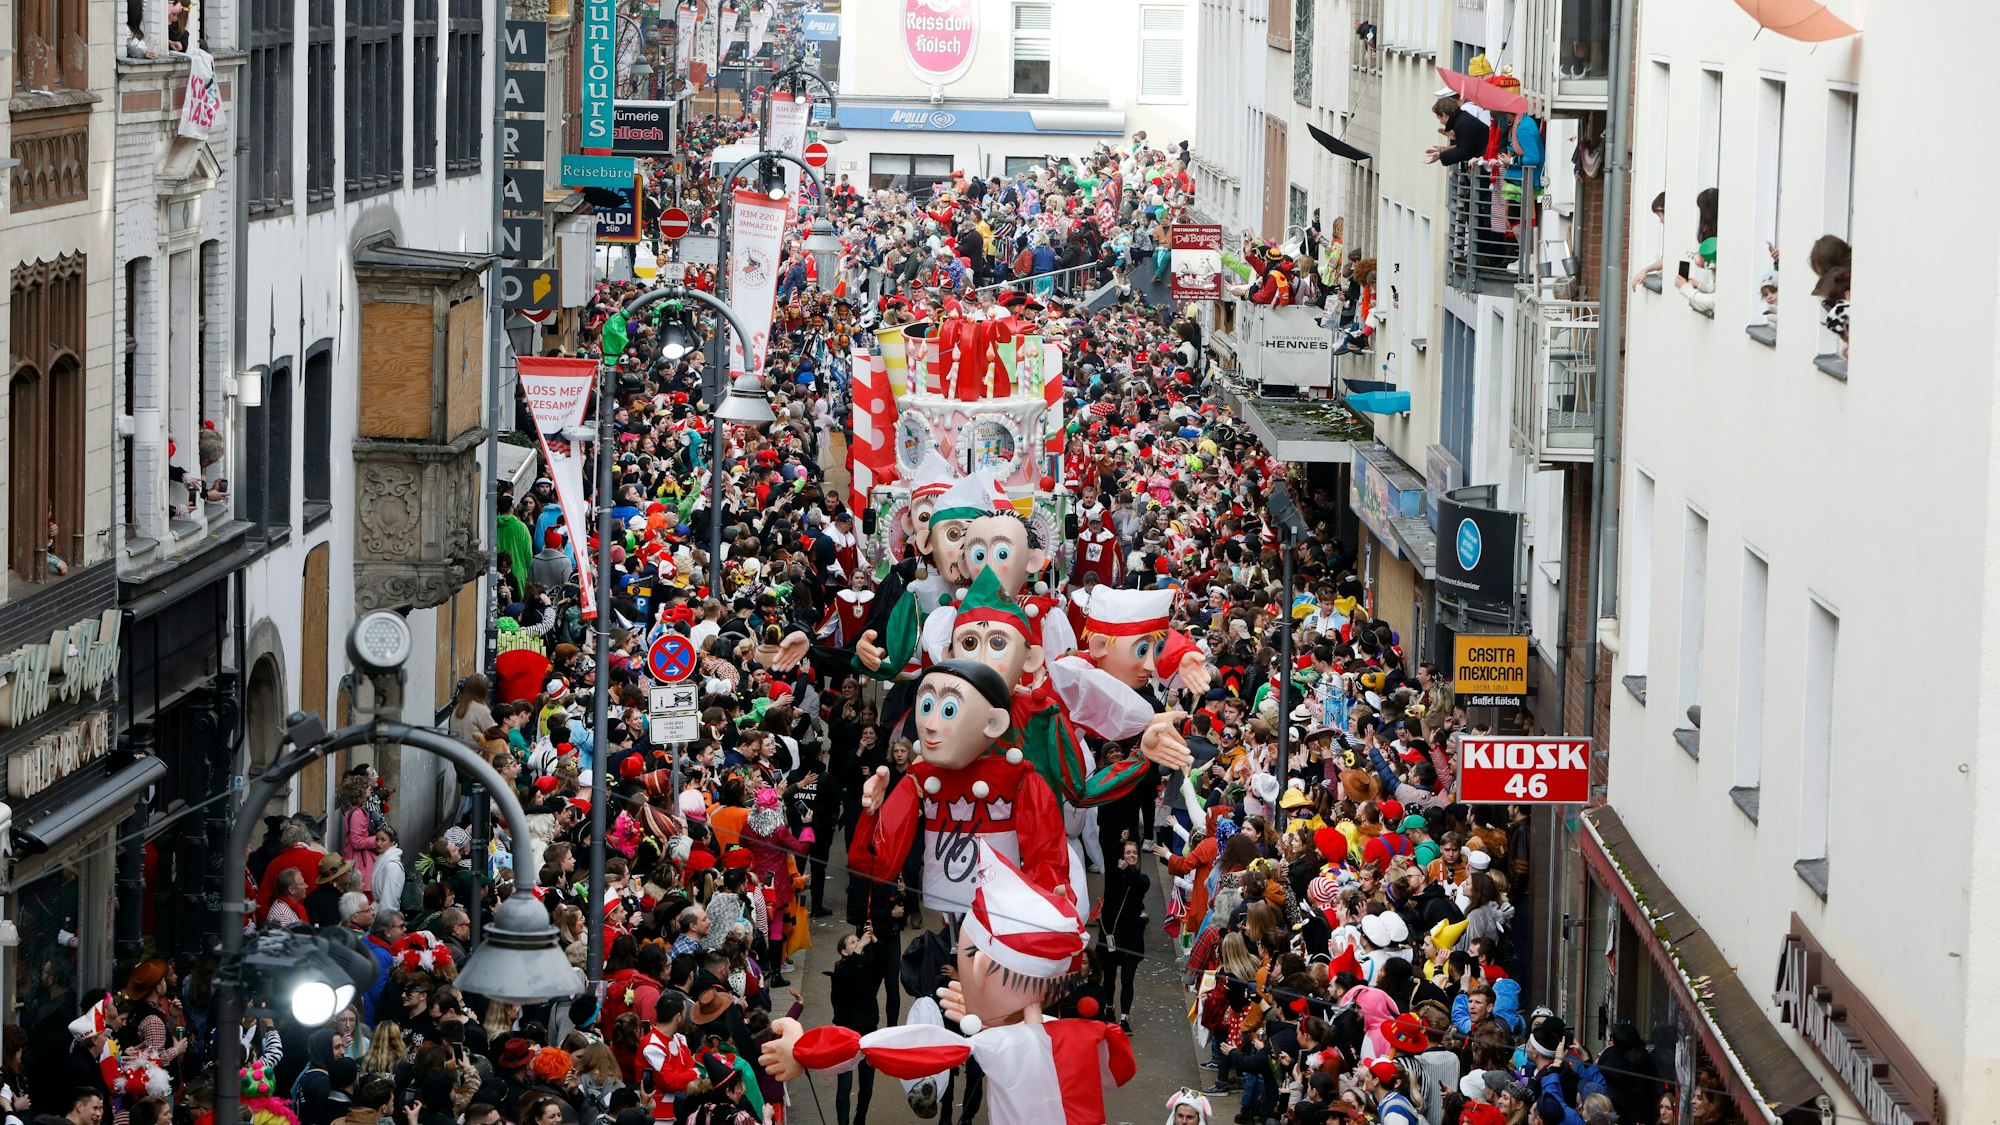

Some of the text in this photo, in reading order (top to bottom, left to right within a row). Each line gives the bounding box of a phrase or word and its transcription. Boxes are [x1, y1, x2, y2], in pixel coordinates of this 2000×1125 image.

[806, 20, 836, 32] APOLLO
[915, 34, 962, 56] Kölsch
[588, 0, 611, 137] untours
[890, 110, 929, 123] APOLLO
[563, 164, 632, 179] Reisebüro
[596, 212, 632, 225] ALDI
[605, 225, 621, 233] SÜD
[1265, 340, 1328, 350] HENNES
[527, 385, 556, 396] LOSS
[1468, 647, 1516, 664] CASITA
[1459, 665, 1524, 682] MEXICANA
[1472, 695, 1521, 707] Gaffel Kölsch
[1463, 743, 1588, 770] KIOSK
[1504, 772, 1549, 799] 46
[793, 792, 817, 801] SWAT
